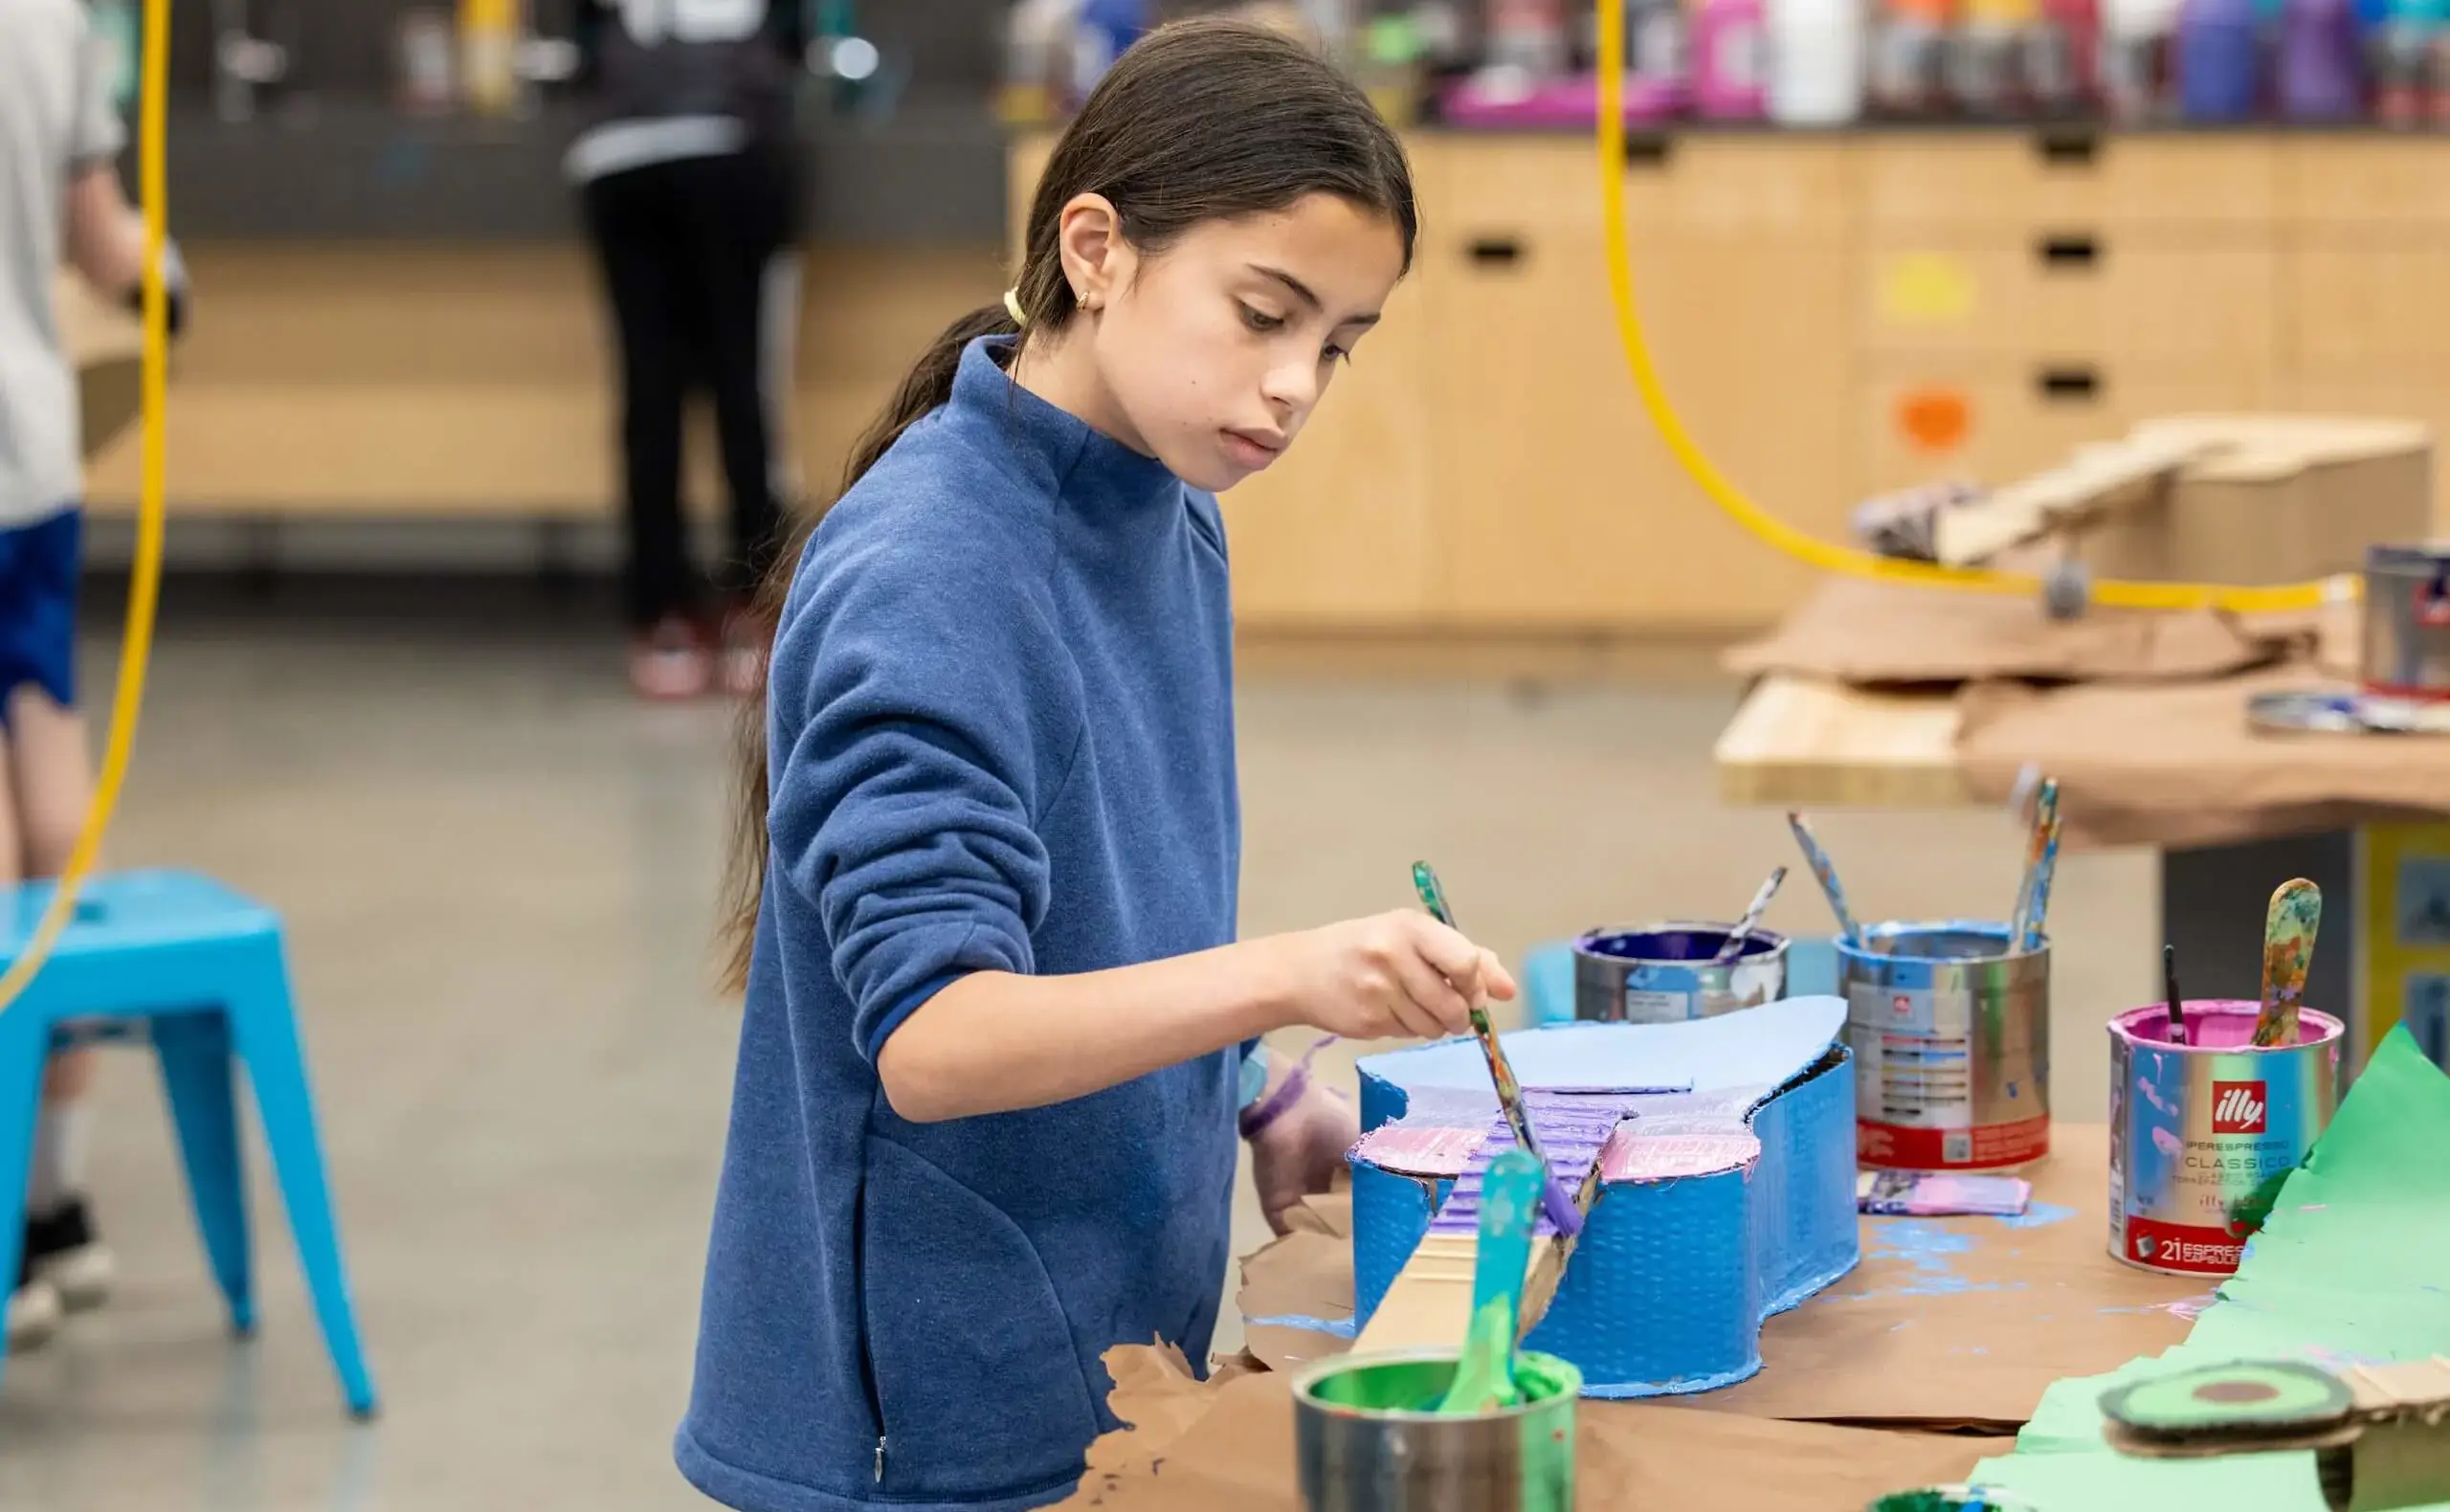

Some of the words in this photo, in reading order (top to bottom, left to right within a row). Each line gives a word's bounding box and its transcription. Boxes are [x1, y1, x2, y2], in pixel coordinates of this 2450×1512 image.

[2215, 1088, 2263, 1129] illy
[2186, 1142, 2289, 1151] IPERESPRESSO
[2185, 1156, 2290, 1169] CLASSICO
